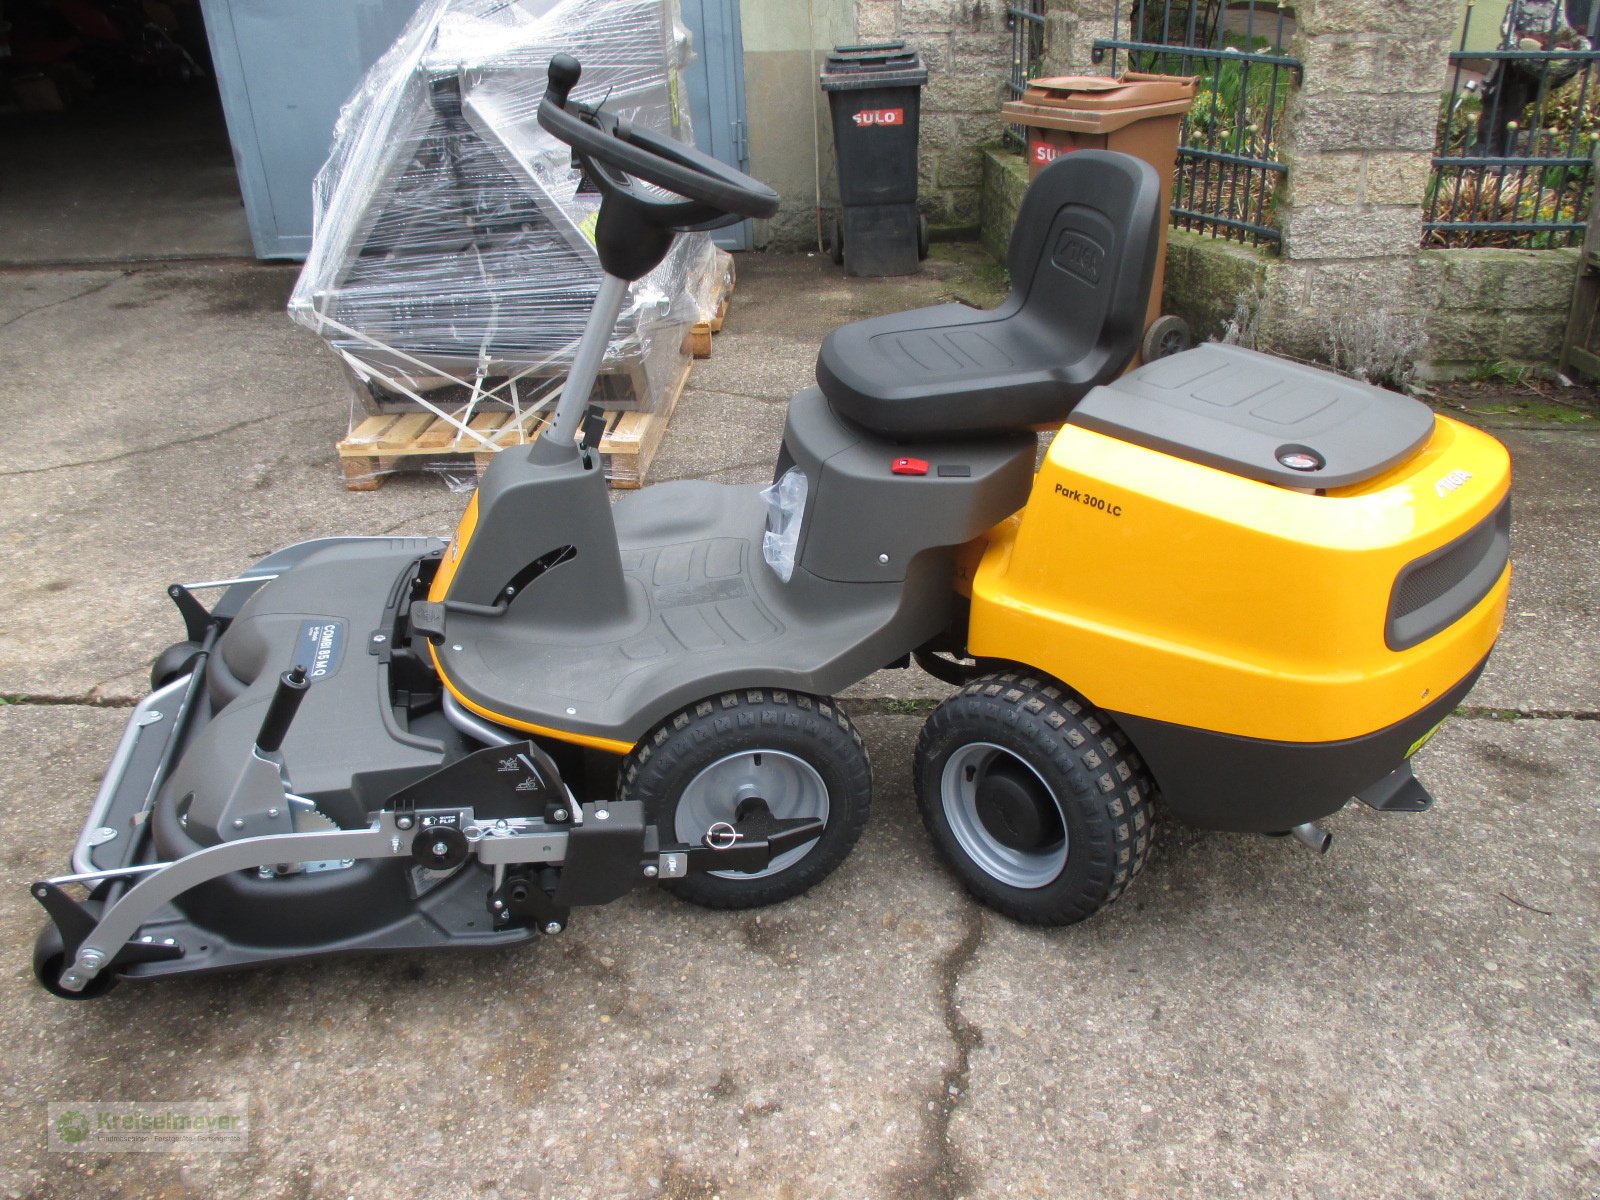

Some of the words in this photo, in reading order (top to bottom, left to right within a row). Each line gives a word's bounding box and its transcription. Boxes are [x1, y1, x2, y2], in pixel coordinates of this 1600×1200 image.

[852, 112, 896, 124] SULO
[1055, 483, 1081, 502] Park
[1083, 494, 1105, 510] 300
[1107, 503, 1122, 516] LC
[320, 624, 336, 649] COMBI
[317, 649, 331, 660] 85
[315, 660, 329, 669] M
